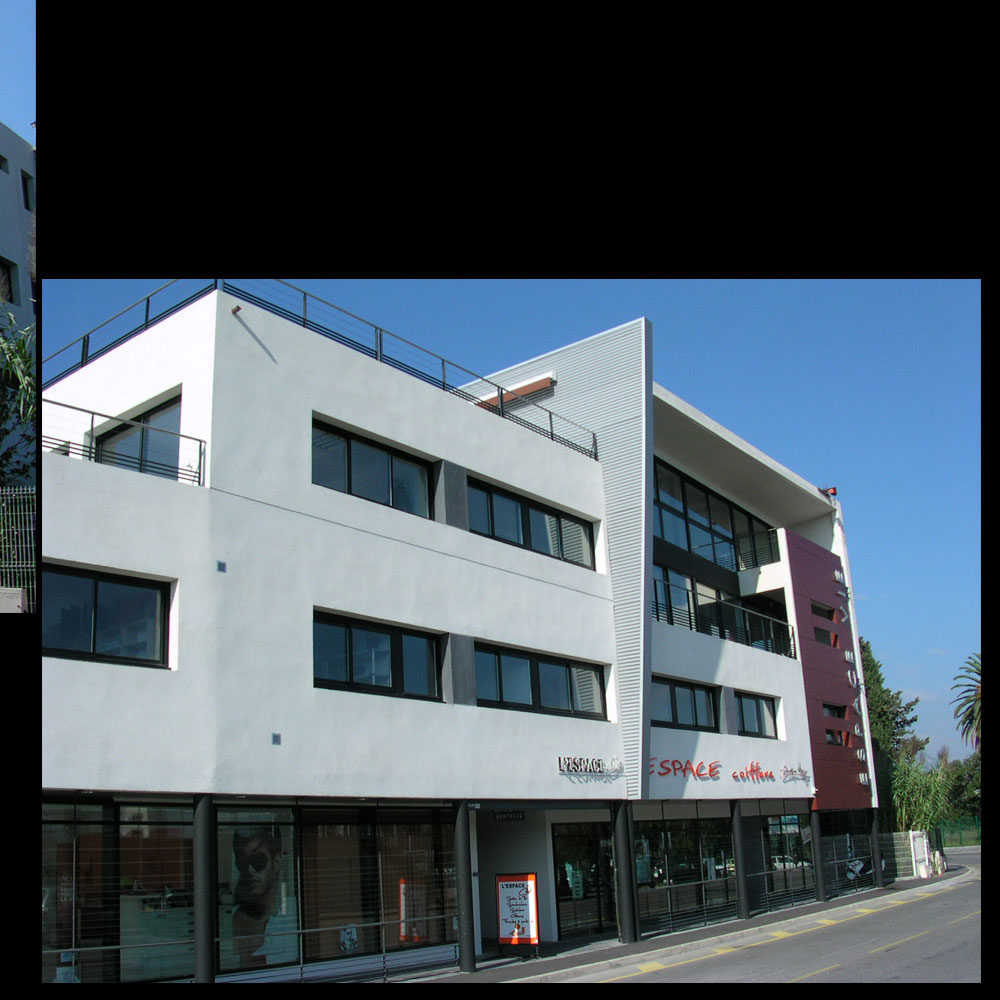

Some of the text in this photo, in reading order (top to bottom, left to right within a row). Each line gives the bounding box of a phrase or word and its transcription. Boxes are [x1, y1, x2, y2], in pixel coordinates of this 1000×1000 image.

[833, 568, 868, 785] ESPACE VIE
[558, 756, 605, 774] L'ESPACE
[649, 757, 721, 778] ESPACE
[731, 760, 775, 781] coiffure
